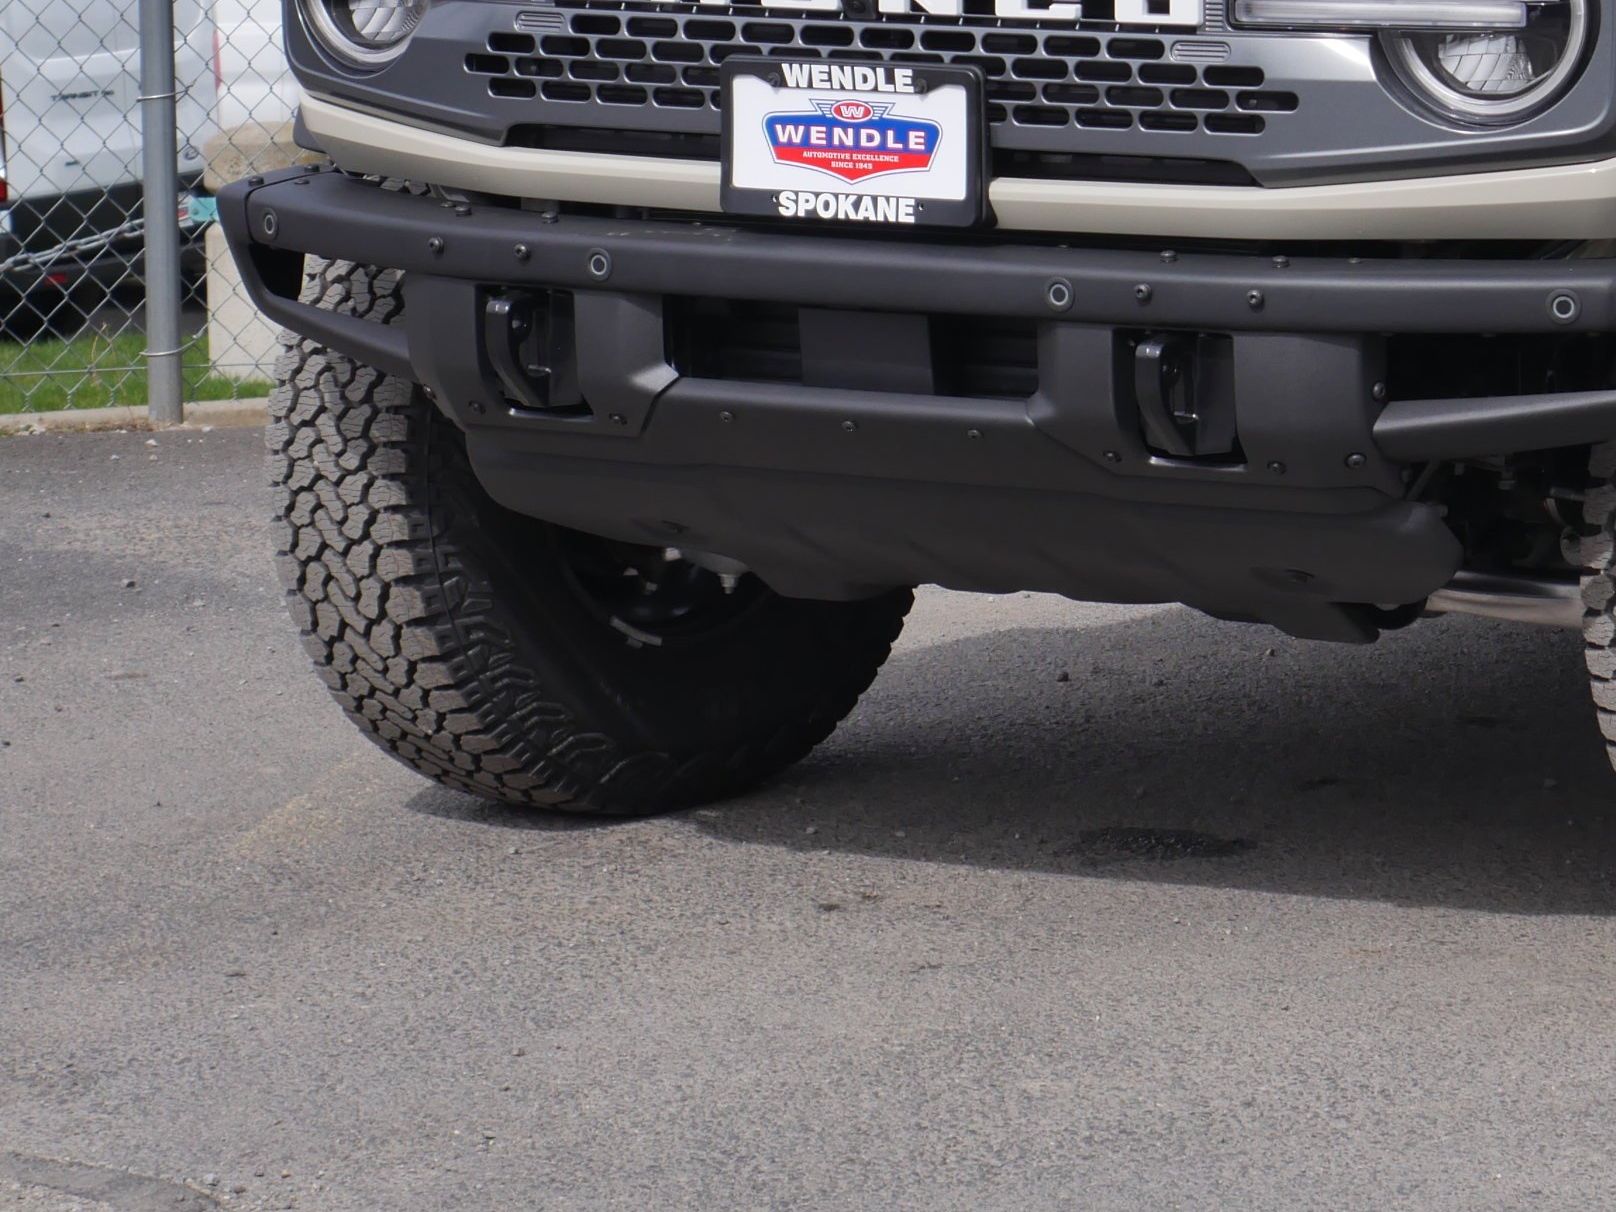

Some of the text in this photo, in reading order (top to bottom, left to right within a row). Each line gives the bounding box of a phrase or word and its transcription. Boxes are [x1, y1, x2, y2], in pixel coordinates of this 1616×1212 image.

[781, 62, 915, 93] WENDLE
[774, 124, 926, 150] WENDLE
[802, 150, 899, 163] AUTOMOTIVE EXCELLENCE
[831, 160, 854, 170] SINCE
[778, 190, 916, 224] SPOKANE
